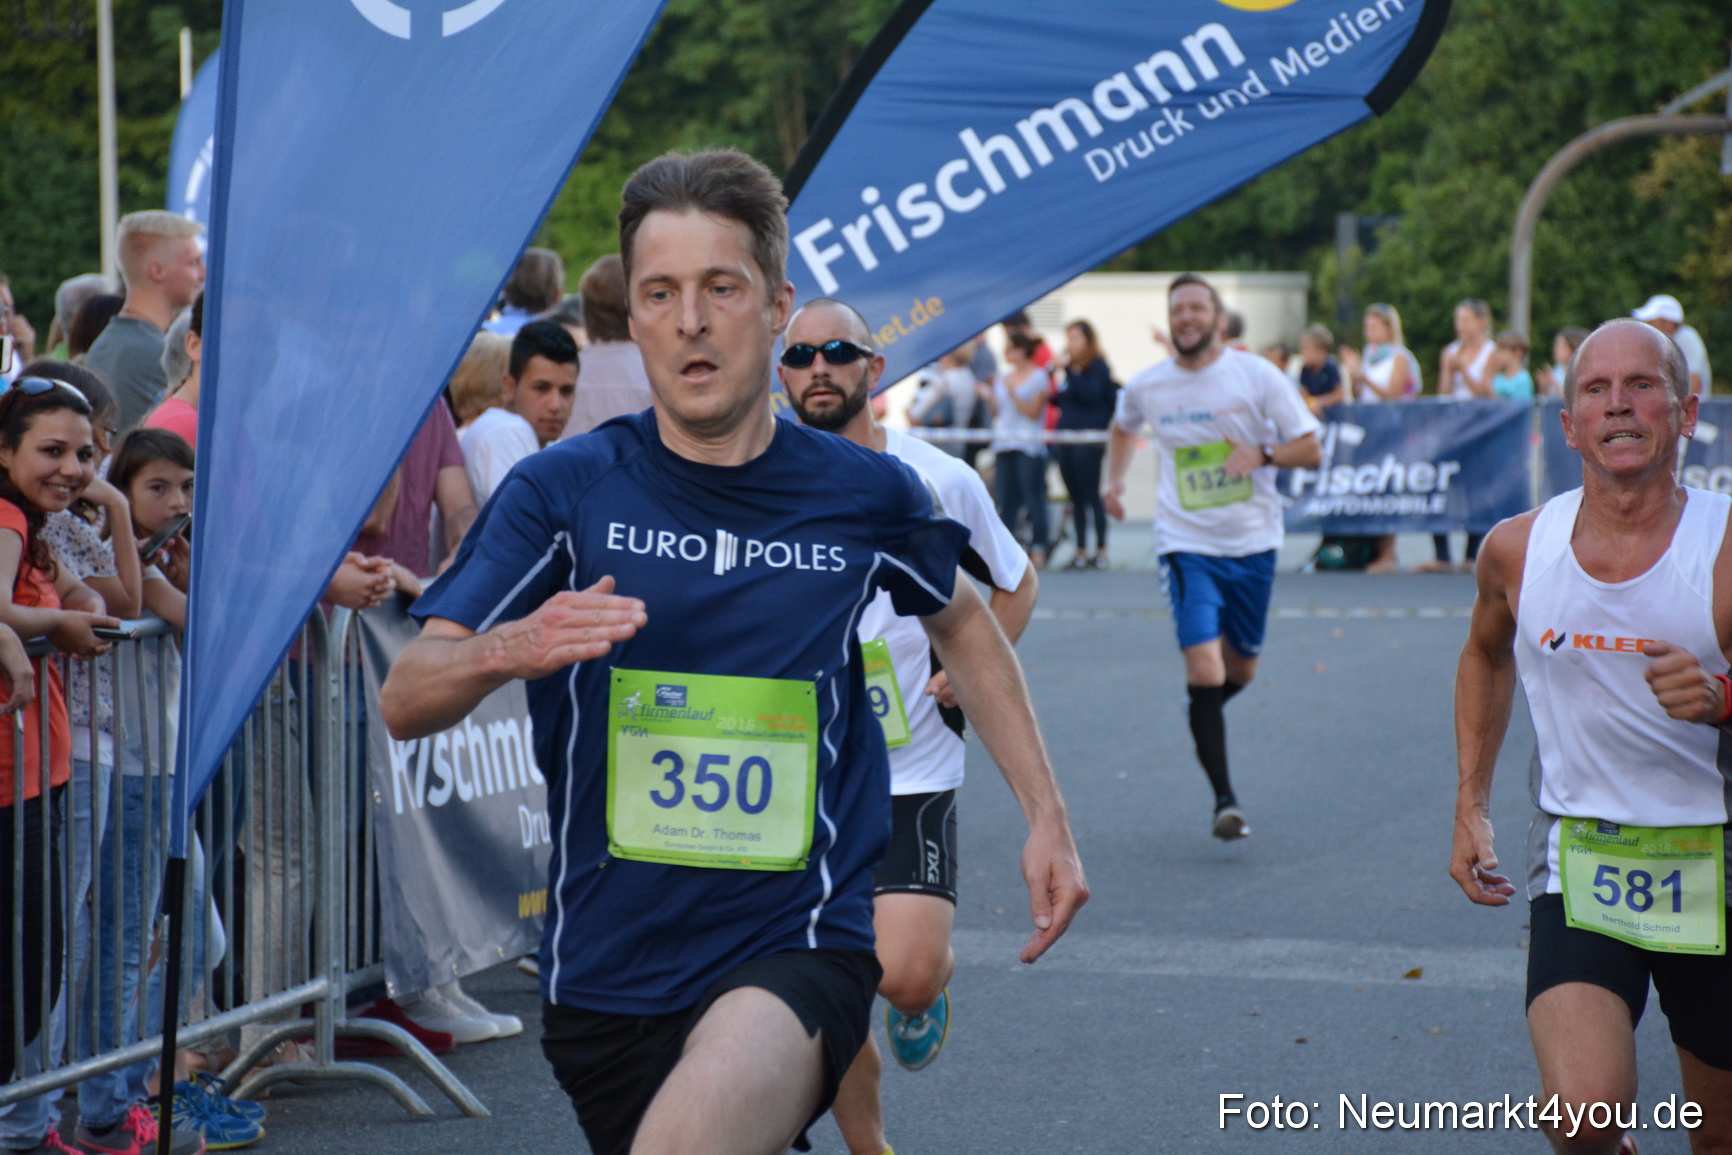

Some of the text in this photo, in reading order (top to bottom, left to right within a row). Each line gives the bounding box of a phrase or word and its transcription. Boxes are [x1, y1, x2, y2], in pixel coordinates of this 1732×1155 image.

[1083, 0, 1406, 183] Druck und Medien
[793, 21, 1248, 296] Frischmann
[1289, 451, 1460, 497] Fischer
[1305, 493, 1448, 517] AUTOMOBILE
[607, 521, 847, 573] EURO POLES
[641, 703, 717, 721] firmenlauf
[649, 749, 773, 815] 350
[652, 823, 762, 842] Adam Dr. Thomas
[1585, 830, 1641, 847] firmenlauf
[1592, 863, 1682, 914] 581
[1602, 913, 1641, 931] Berthold
[1643, 923, 1681, 934] Schmid
